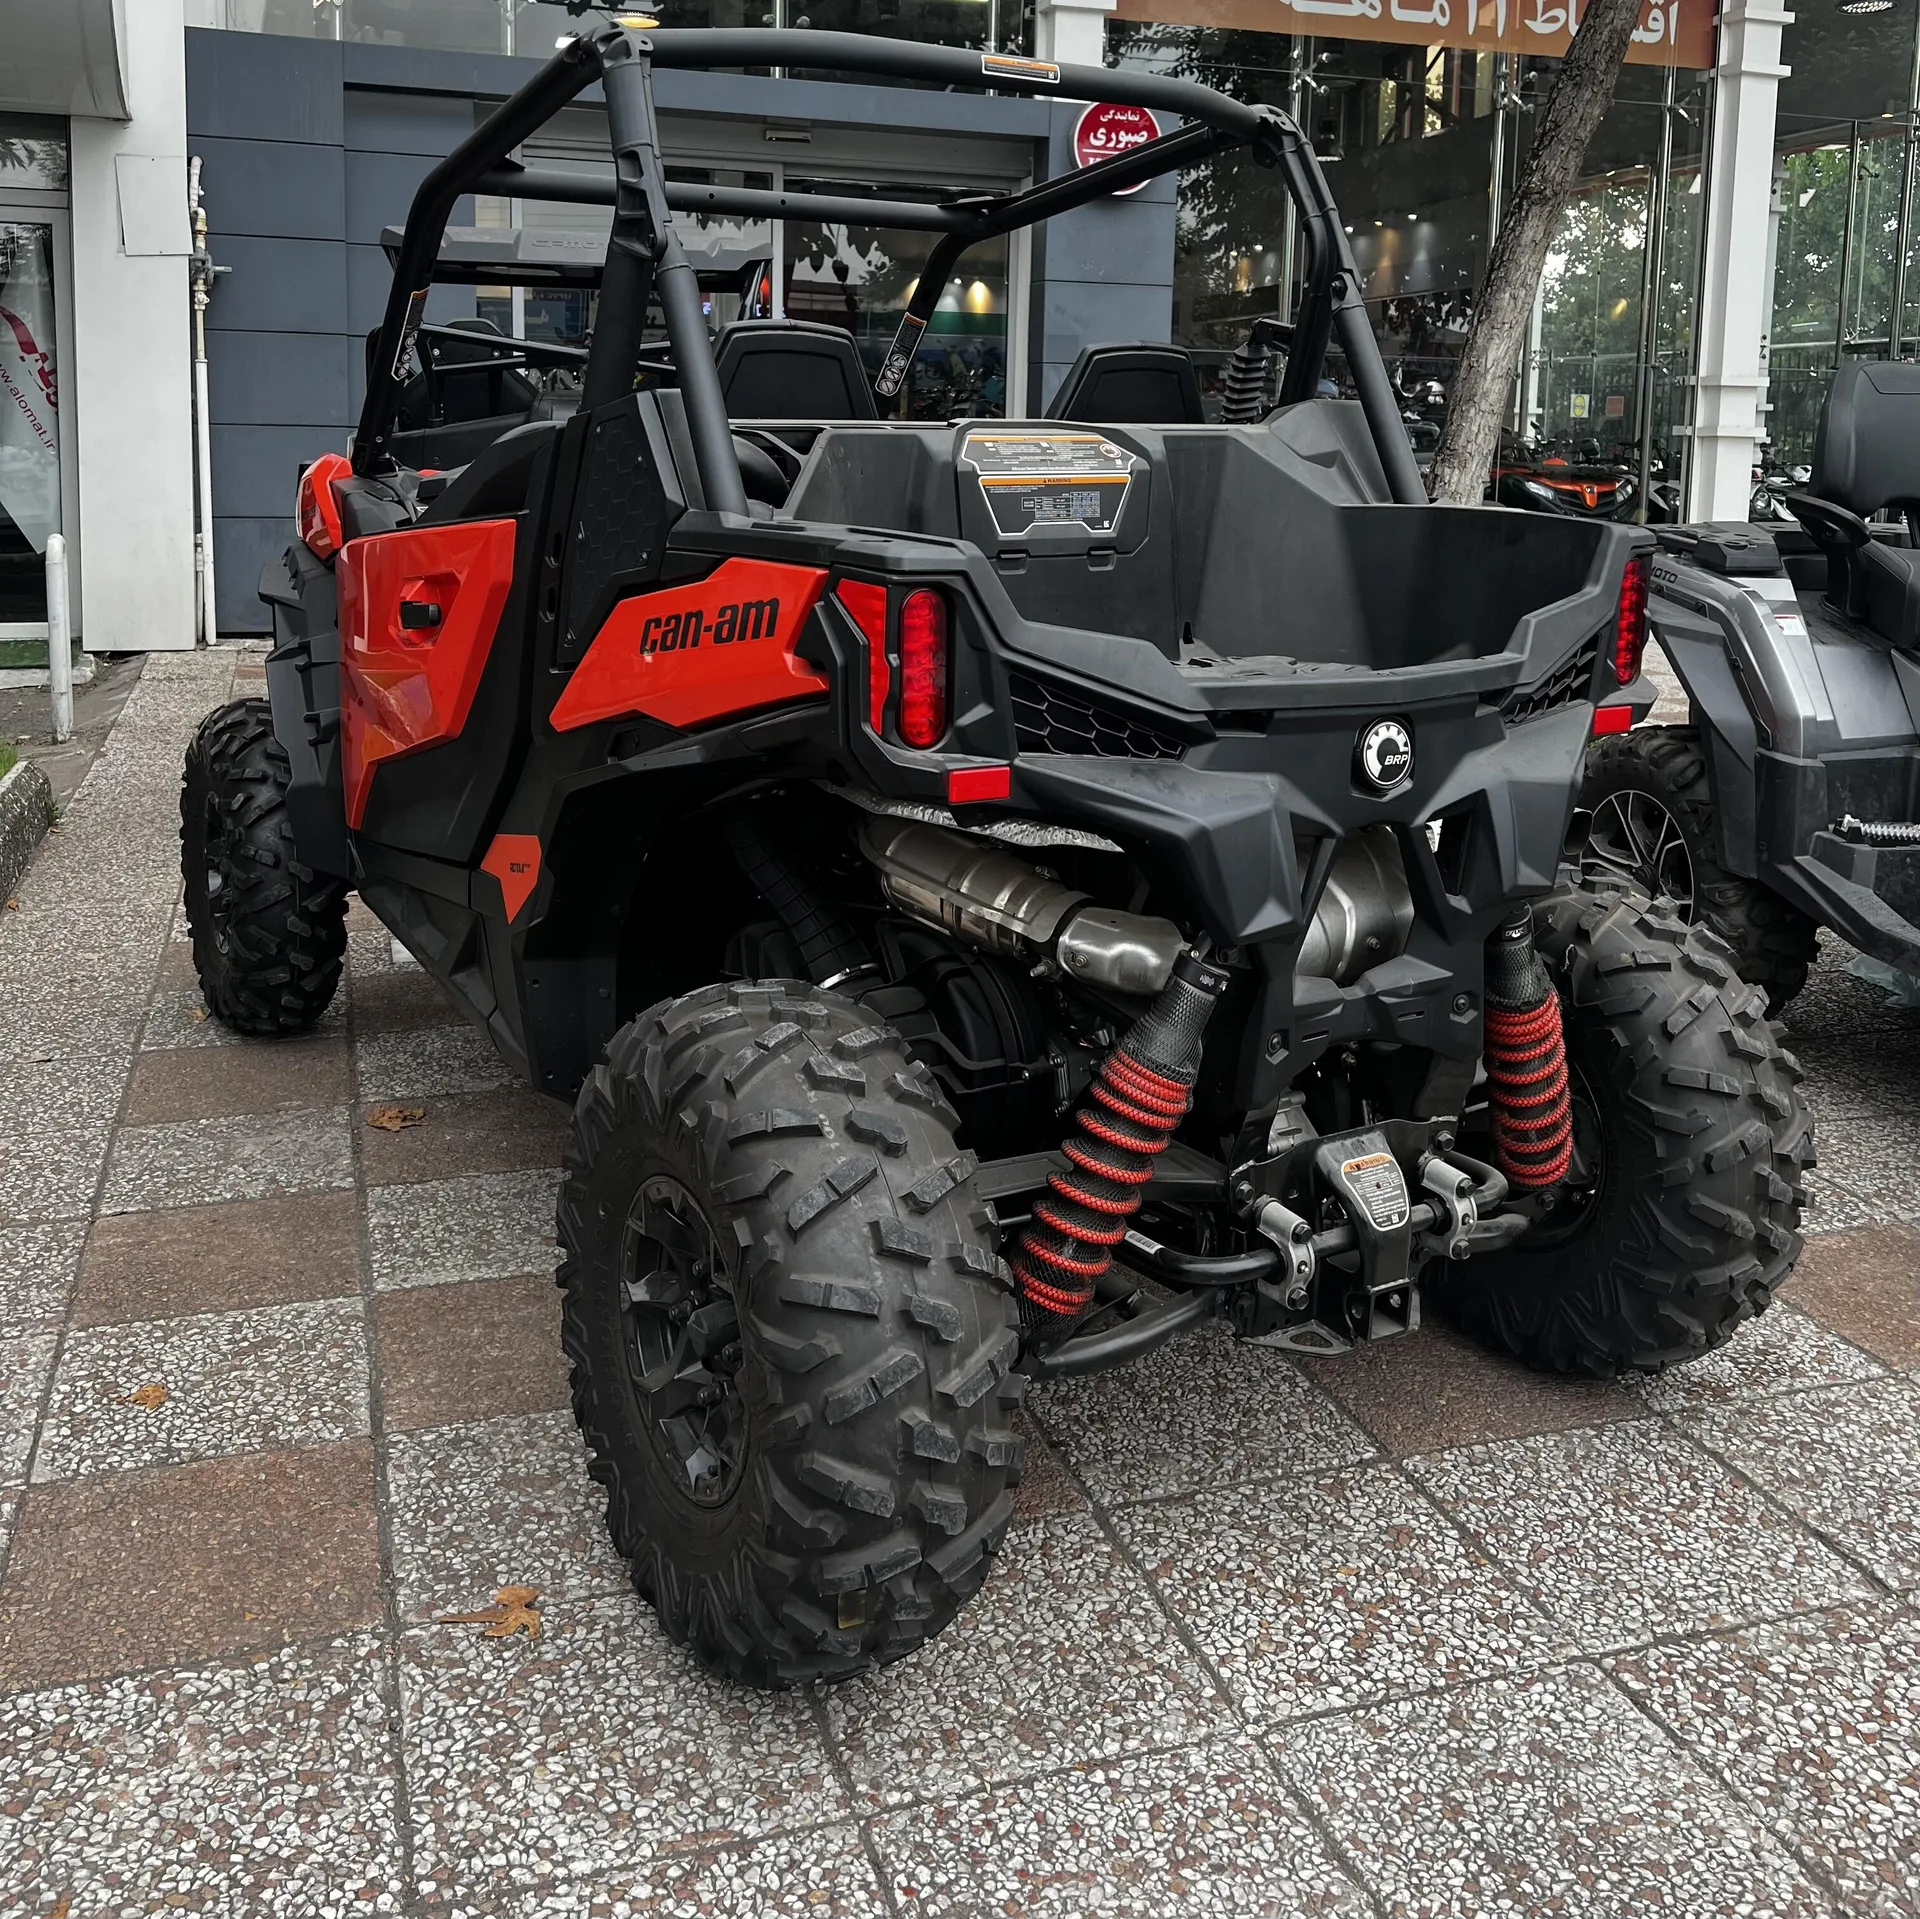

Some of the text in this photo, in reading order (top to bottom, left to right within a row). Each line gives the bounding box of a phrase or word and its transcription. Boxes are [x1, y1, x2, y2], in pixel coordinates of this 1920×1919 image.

[1090, 127, 1148, 148] صبوری
[640, 598, 779, 655] can-am
[1384, 754, 1408, 766] BRP
